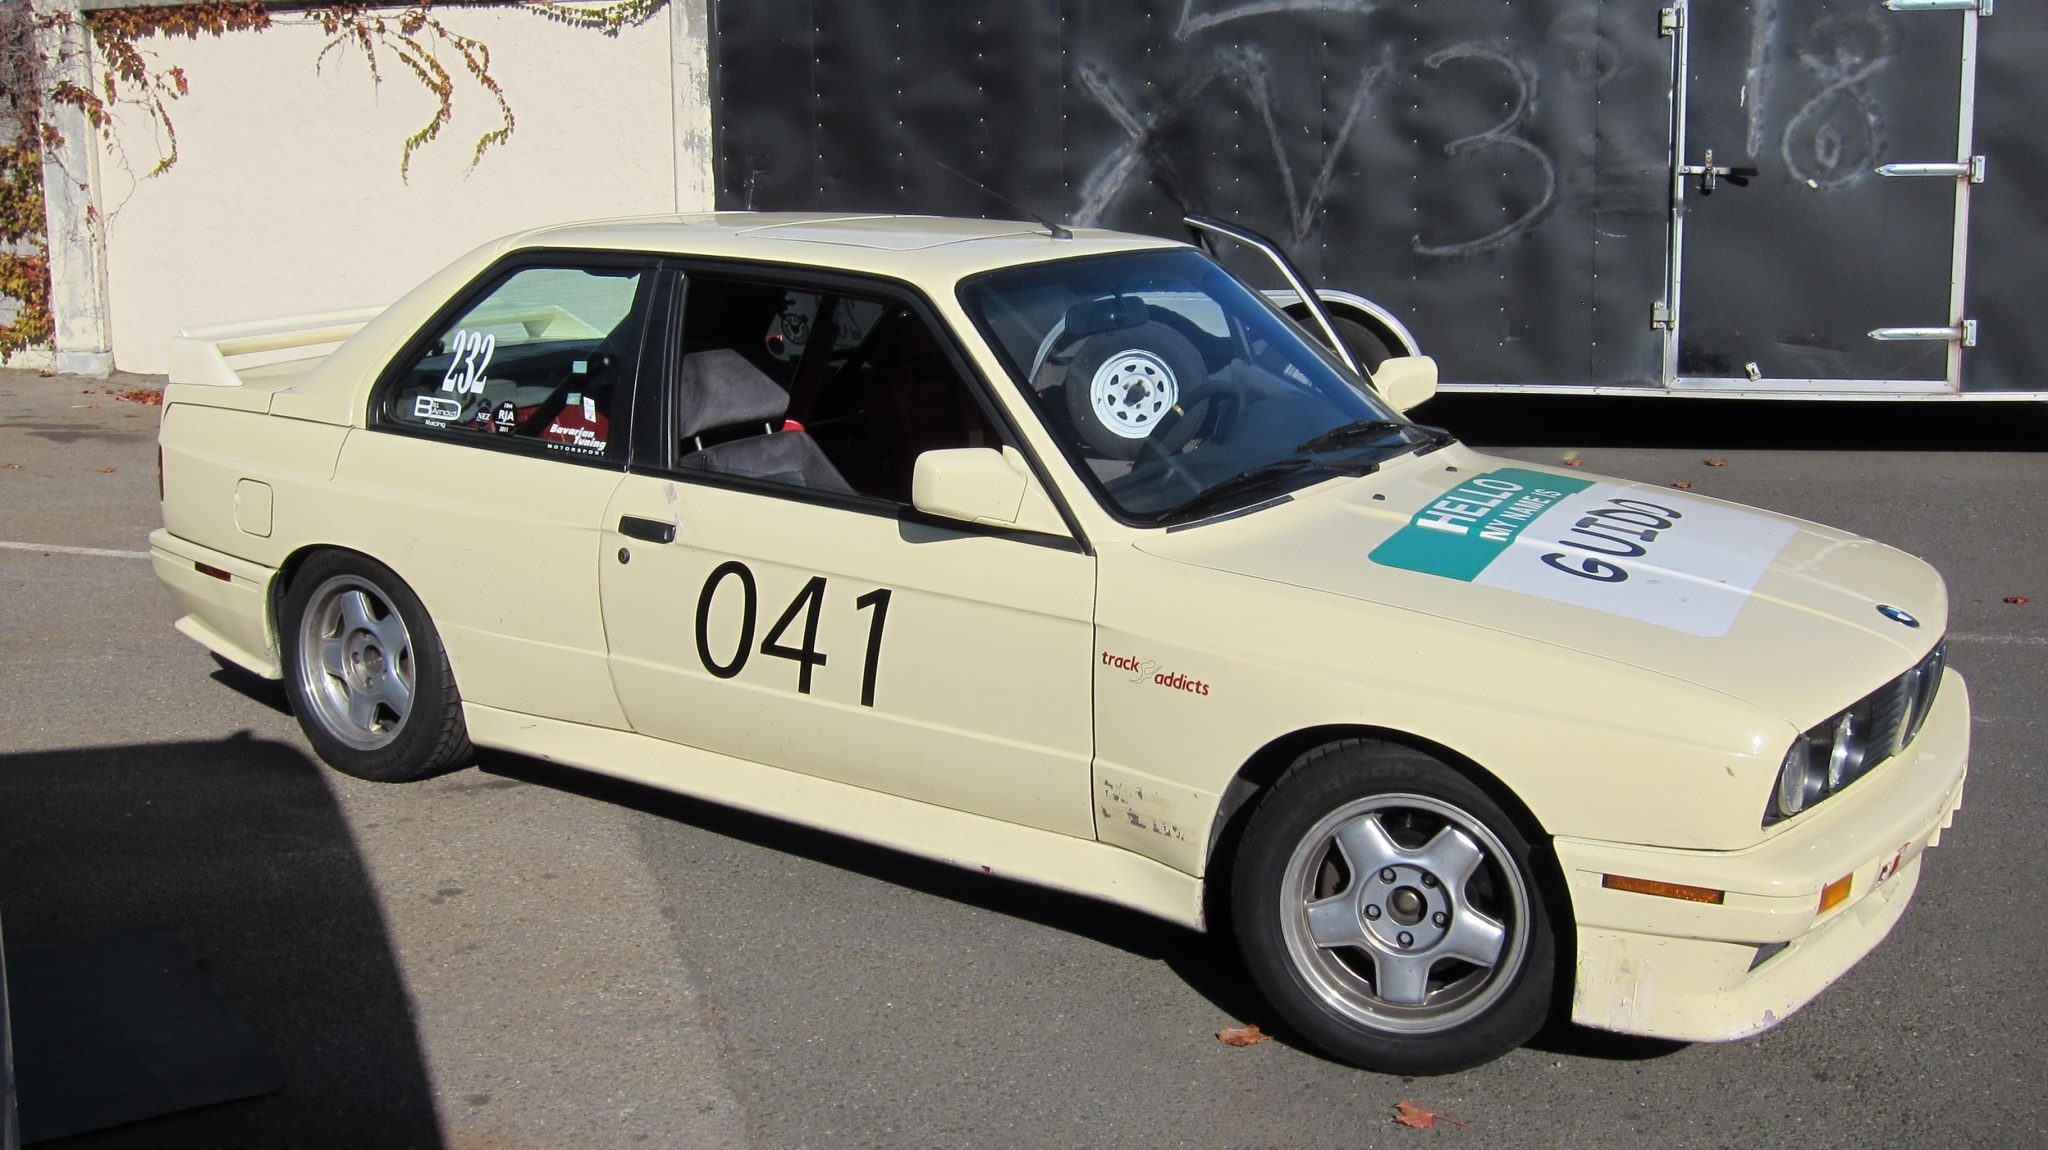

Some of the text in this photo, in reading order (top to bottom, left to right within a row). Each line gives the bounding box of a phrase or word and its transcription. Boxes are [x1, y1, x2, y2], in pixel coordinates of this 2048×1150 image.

[441, 329, 496, 395] 232
[425, 419, 446, 429] Racing
[498, 409, 515, 423] RJA
[549, 423, 596, 439] Bavarian
[546, 443, 606, 457] MOTORSPORT
[573, 436, 607, 452] Tuning
[1416, 478, 1524, 535] HELLO
[1479, 488, 1563, 542] MY NAME IS
[1540, 498, 1683, 583] GUIDO
[695, 560, 893, 708] 041
[1102, 651, 1210, 696] track addicts
